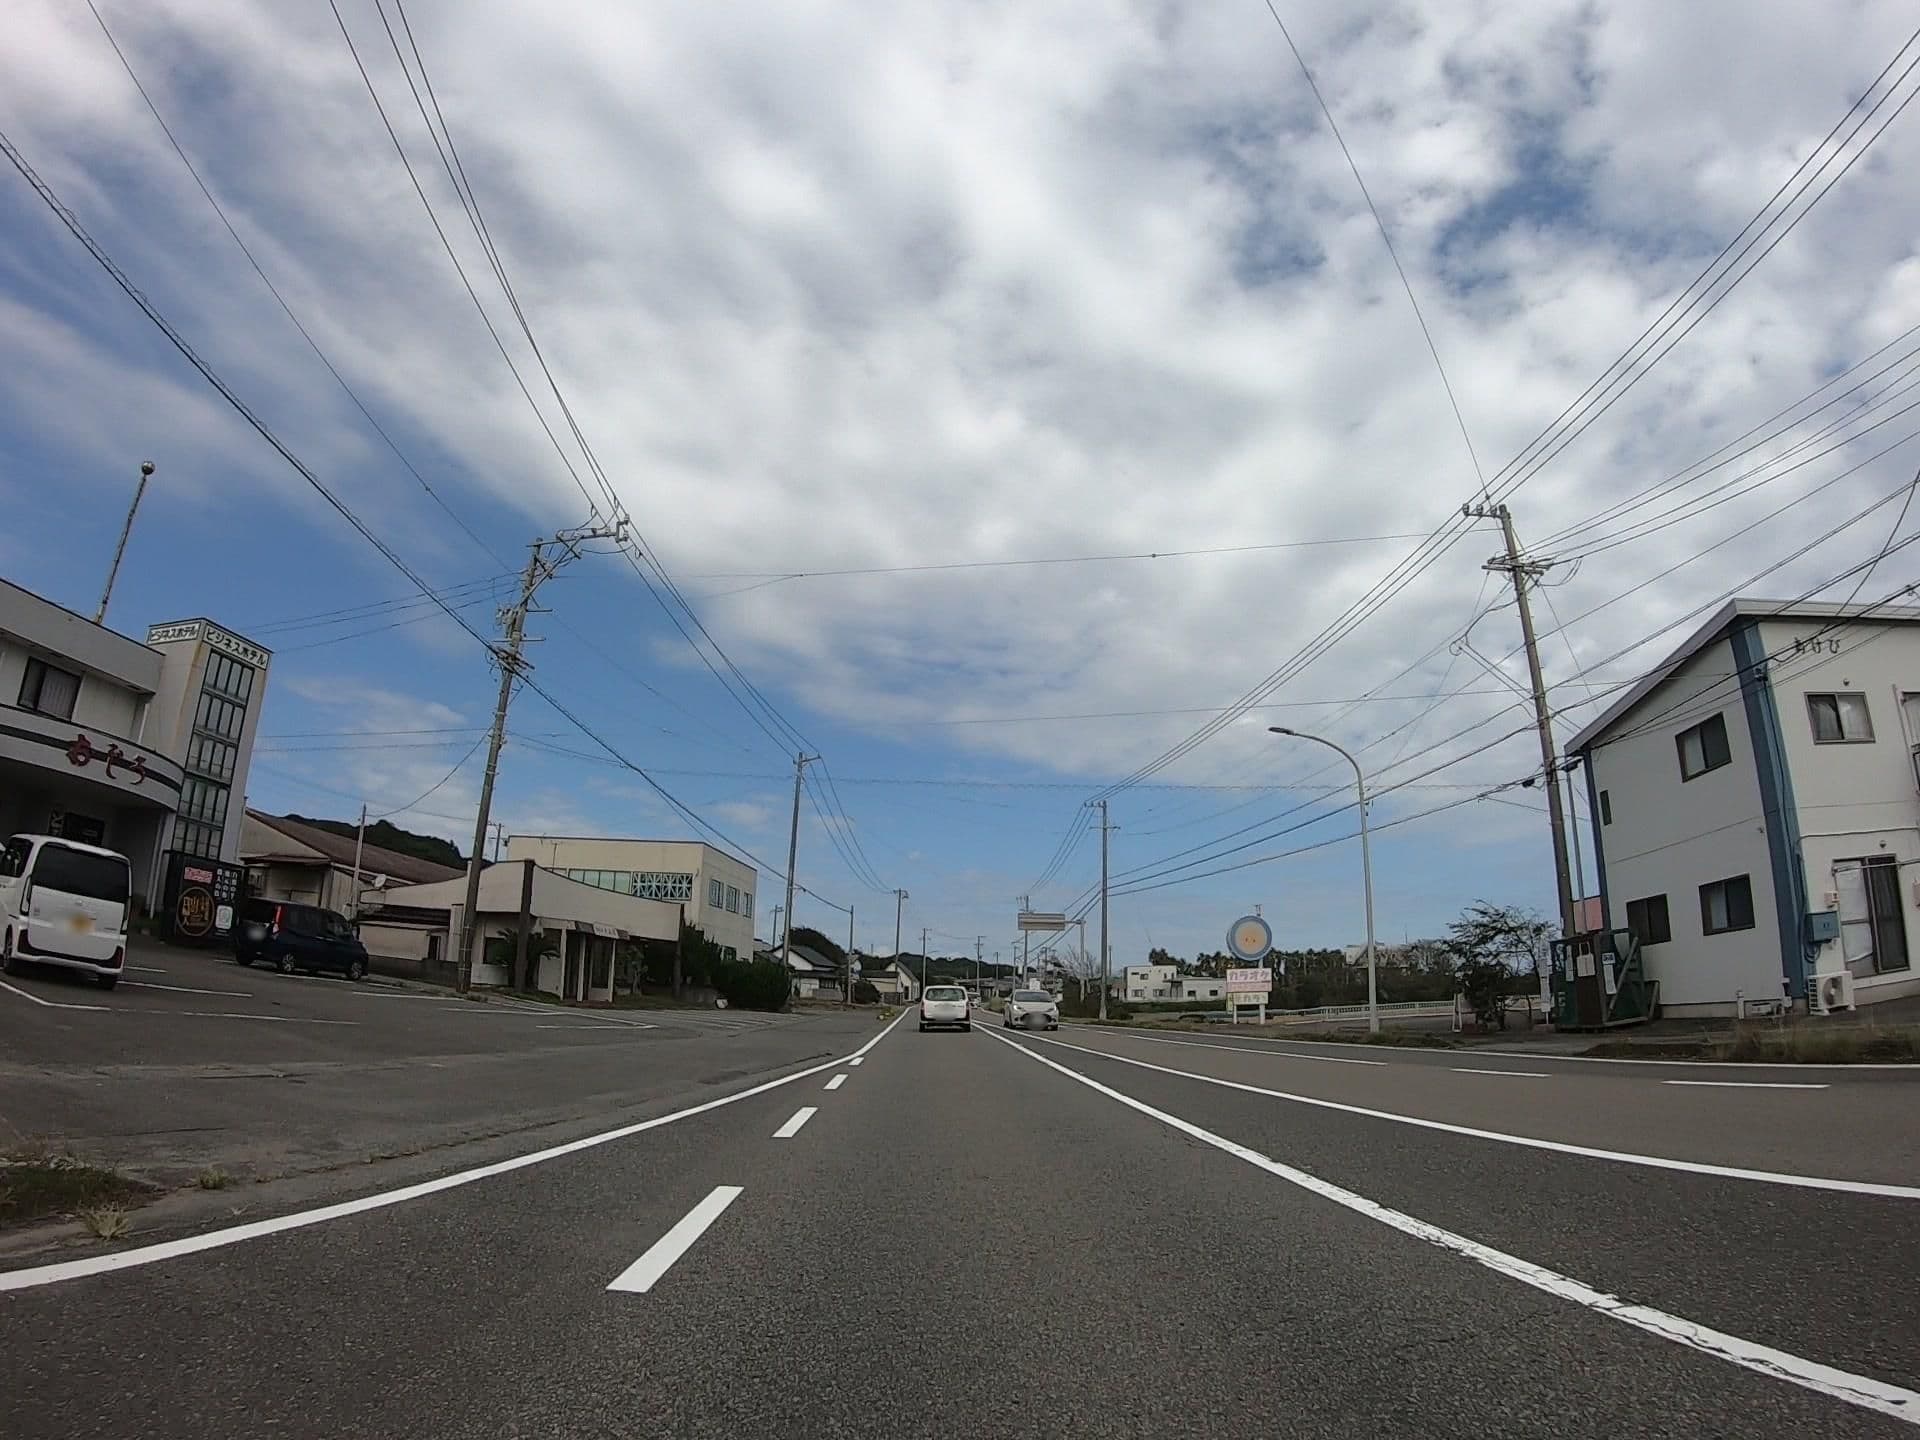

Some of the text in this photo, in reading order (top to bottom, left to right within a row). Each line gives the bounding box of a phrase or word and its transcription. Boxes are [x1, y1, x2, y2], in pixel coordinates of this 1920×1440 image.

[206, 627, 267, 665] ビジネスホテル
